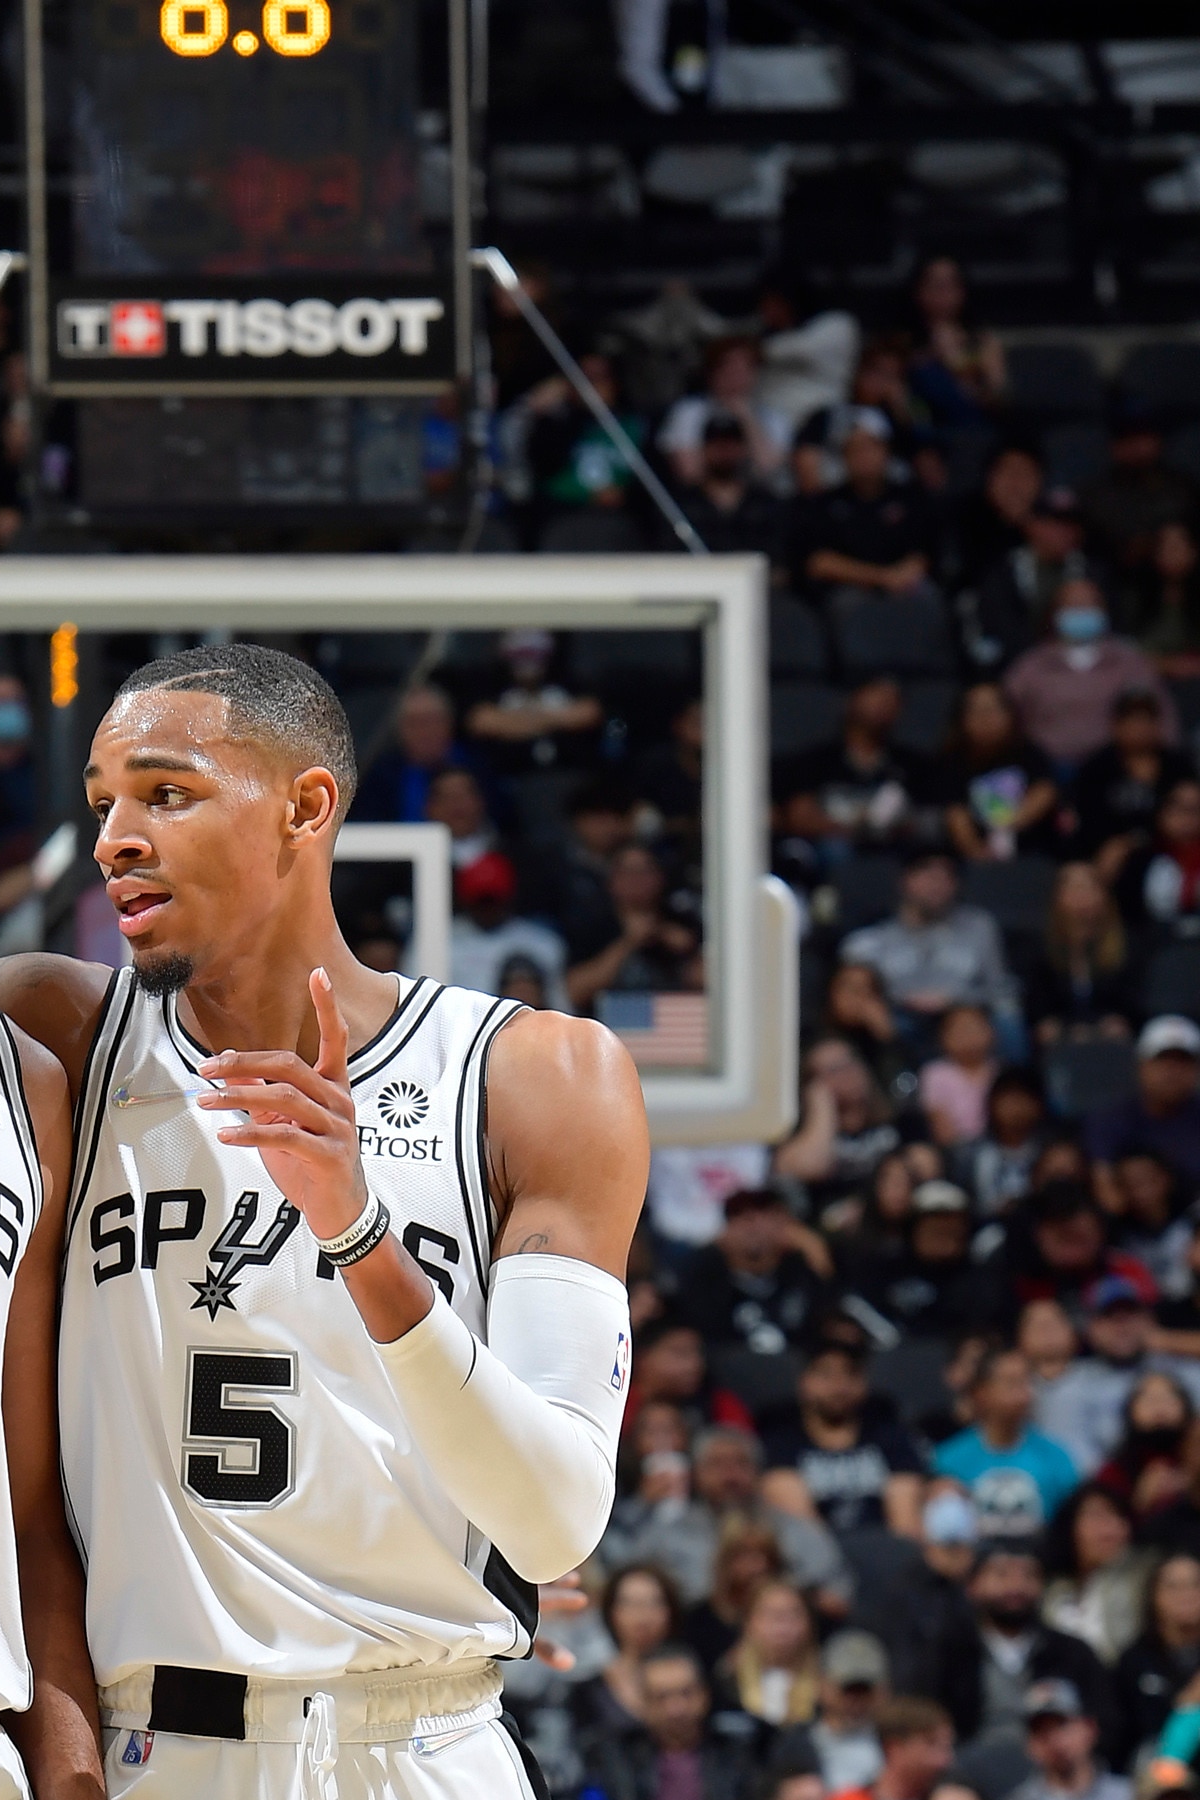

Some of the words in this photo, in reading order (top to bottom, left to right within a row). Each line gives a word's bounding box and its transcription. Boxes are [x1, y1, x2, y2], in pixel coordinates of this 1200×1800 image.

[165, 299, 443, 357] TISSOT
[356, 1125, 444, 1161] Frost
[90, 1188, 461, 1306] SPUS
[180, 1345, 298, 1510] 5
[126, 1749, 137, 1762] 75
